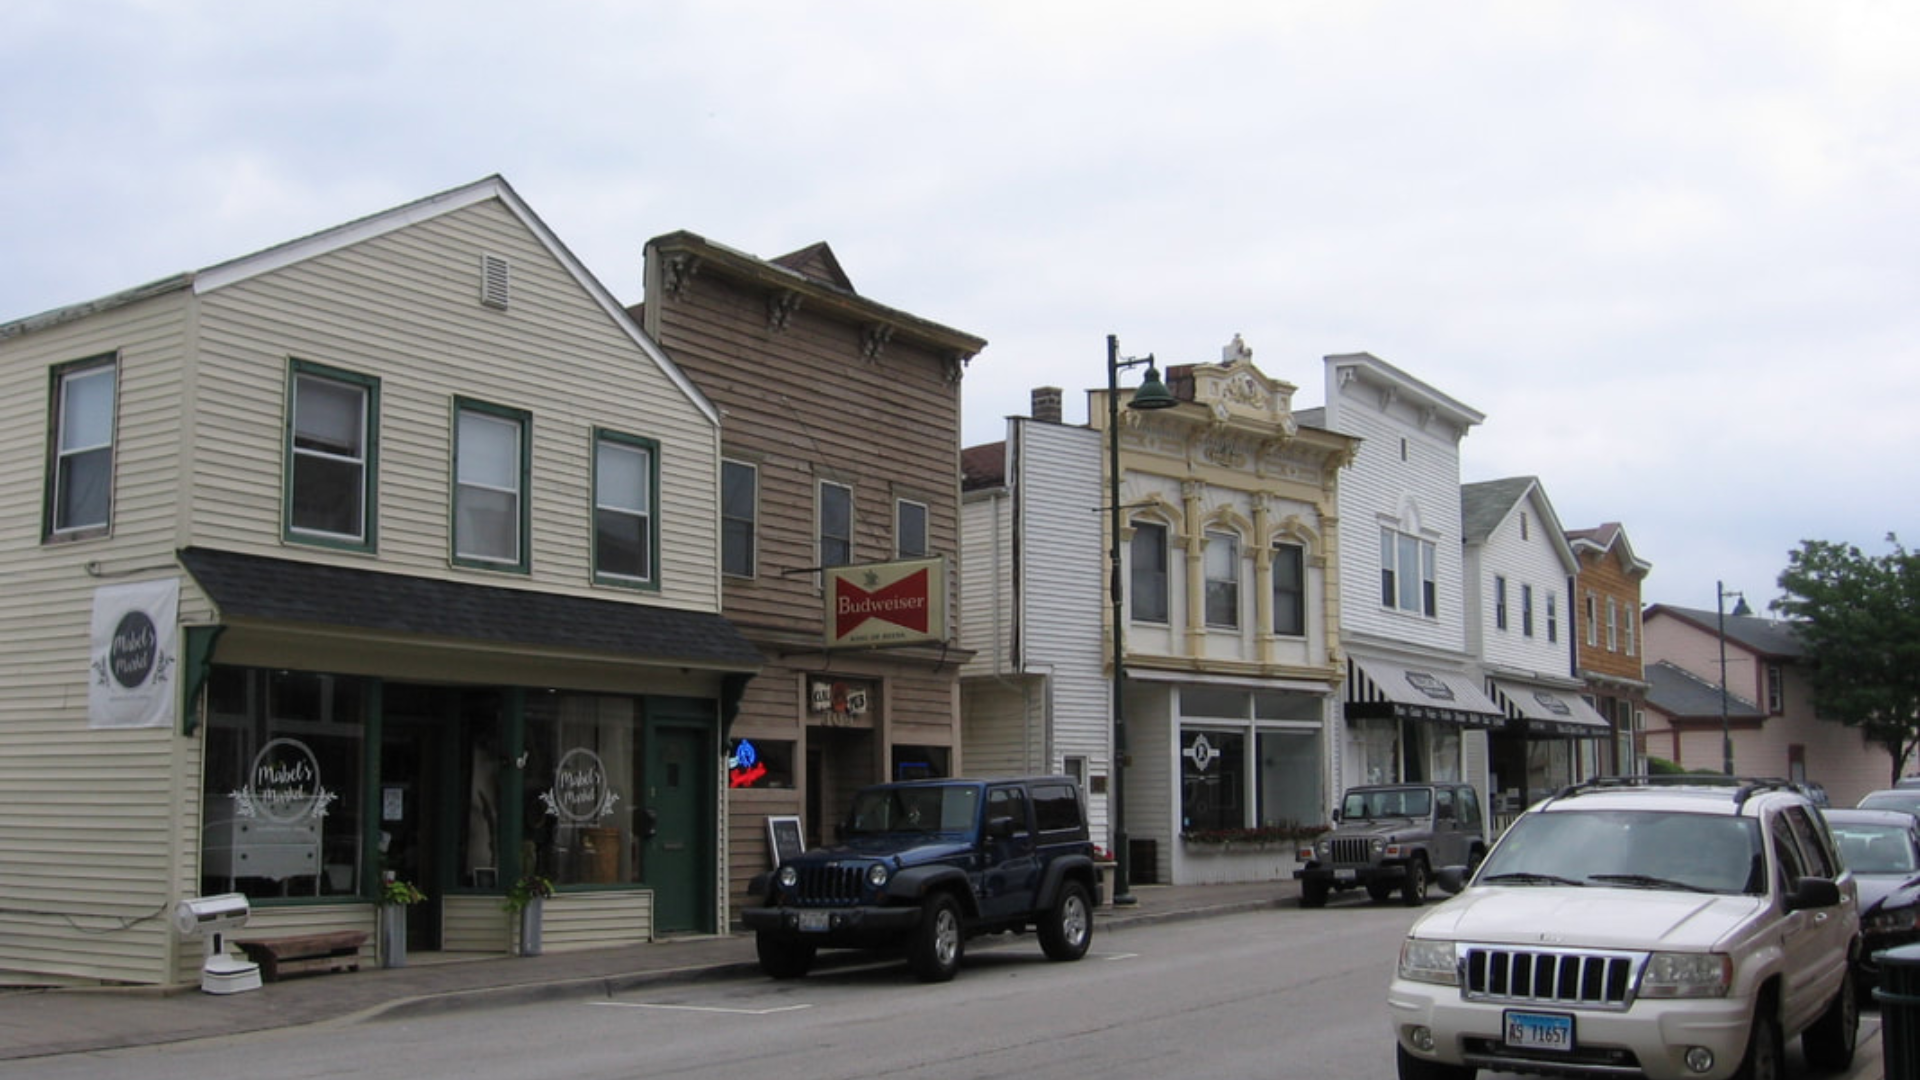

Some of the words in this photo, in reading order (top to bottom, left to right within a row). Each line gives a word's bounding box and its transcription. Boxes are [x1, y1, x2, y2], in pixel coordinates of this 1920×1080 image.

[838, 595, 925, 615] Budweiser
[258, 760, 312, 785] Mabel's
[561, 767, 600, 788] Mabel's
